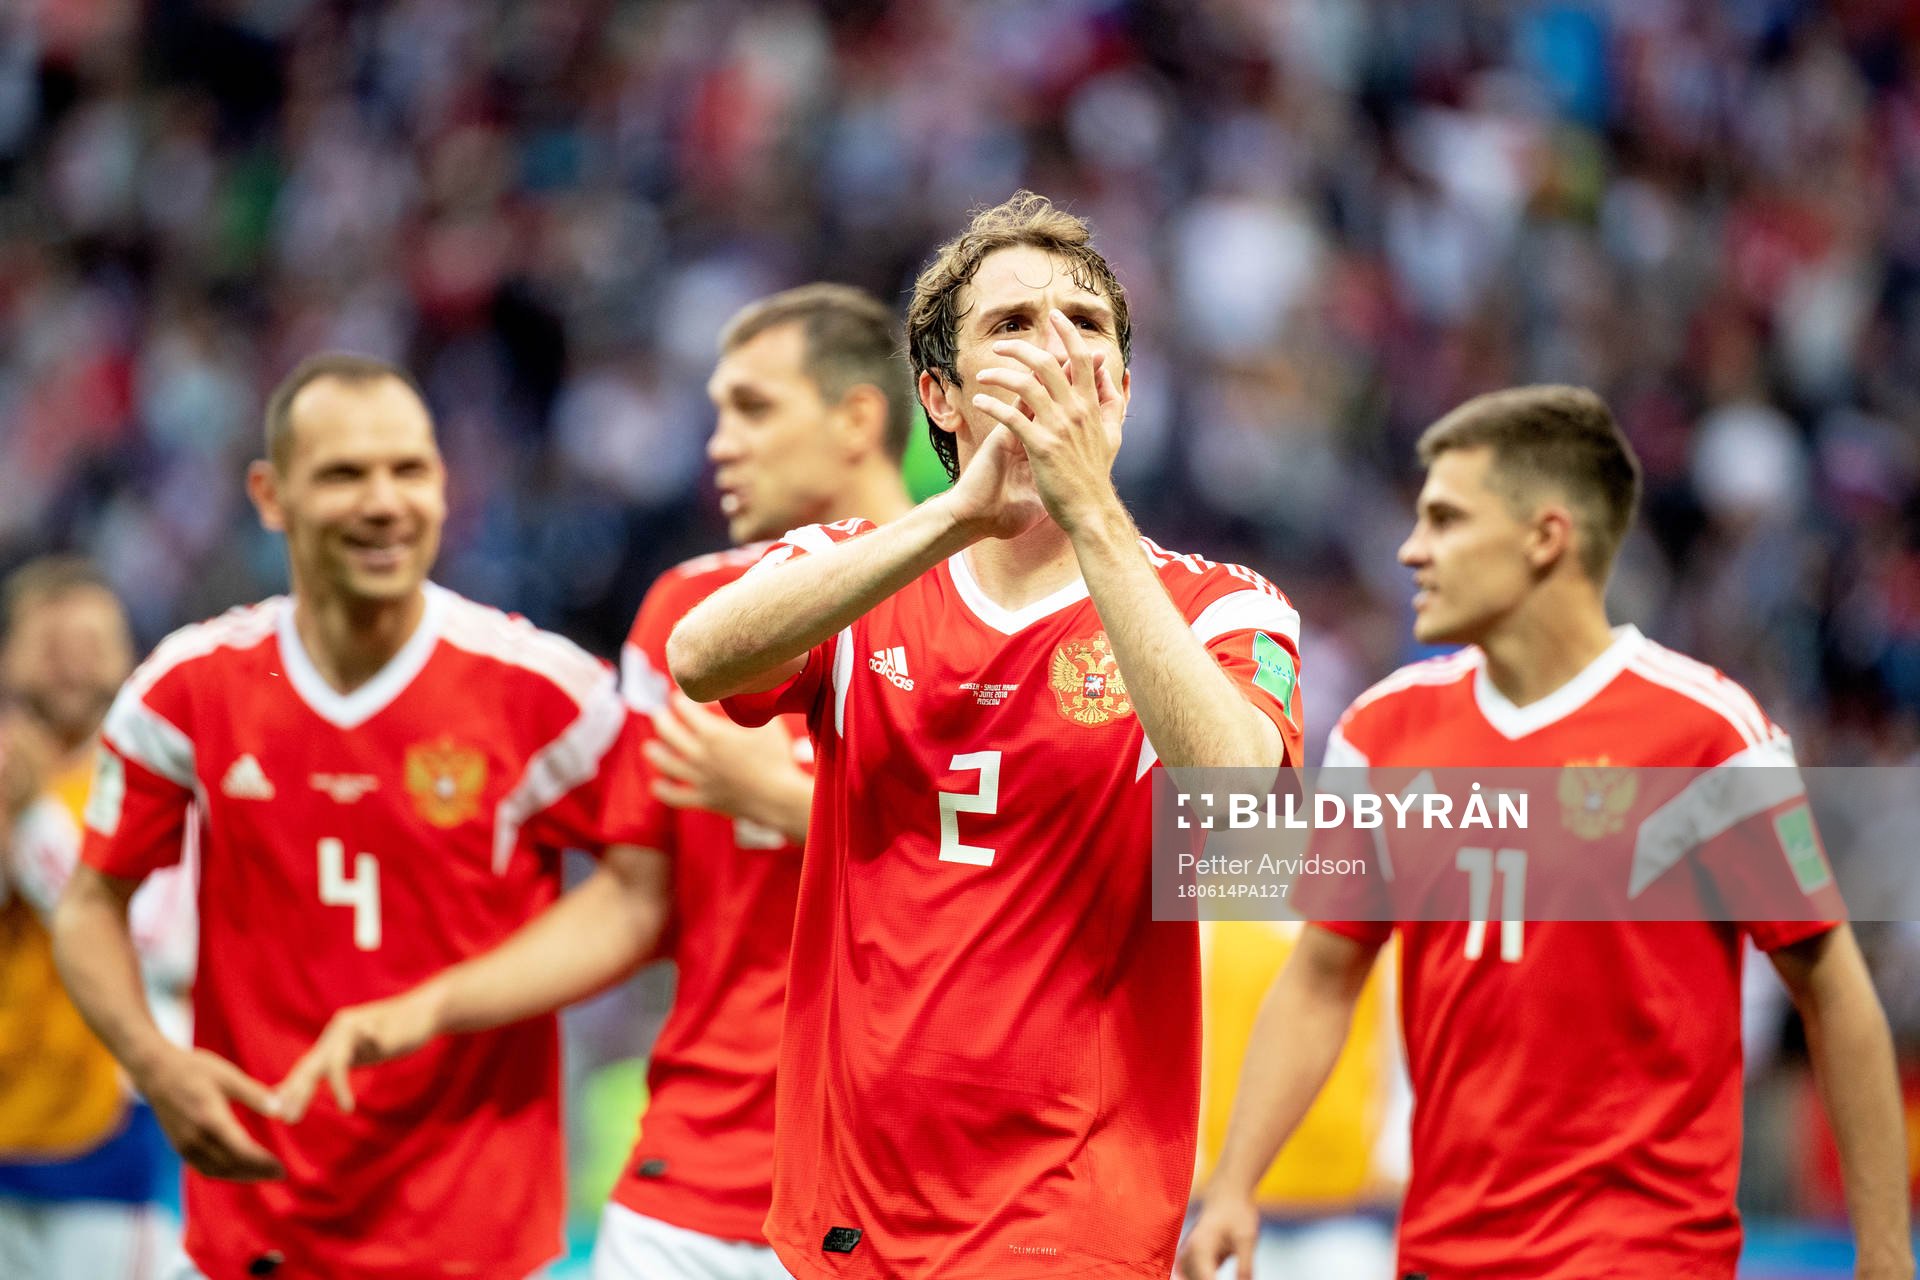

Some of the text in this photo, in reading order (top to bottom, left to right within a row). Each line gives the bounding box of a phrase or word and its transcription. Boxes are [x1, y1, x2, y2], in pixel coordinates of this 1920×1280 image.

[869, 658, 914, 691] adidas
[976, 698, 1001, 706] MOSCOW
[979, 690, 994, 698] JUNE
[994, 690, 1008, 699] 2018
[939, 751, 1002, 867] 2
[318, 838, 381, 950] 4
[1456, 847, 1528, 963] 11
